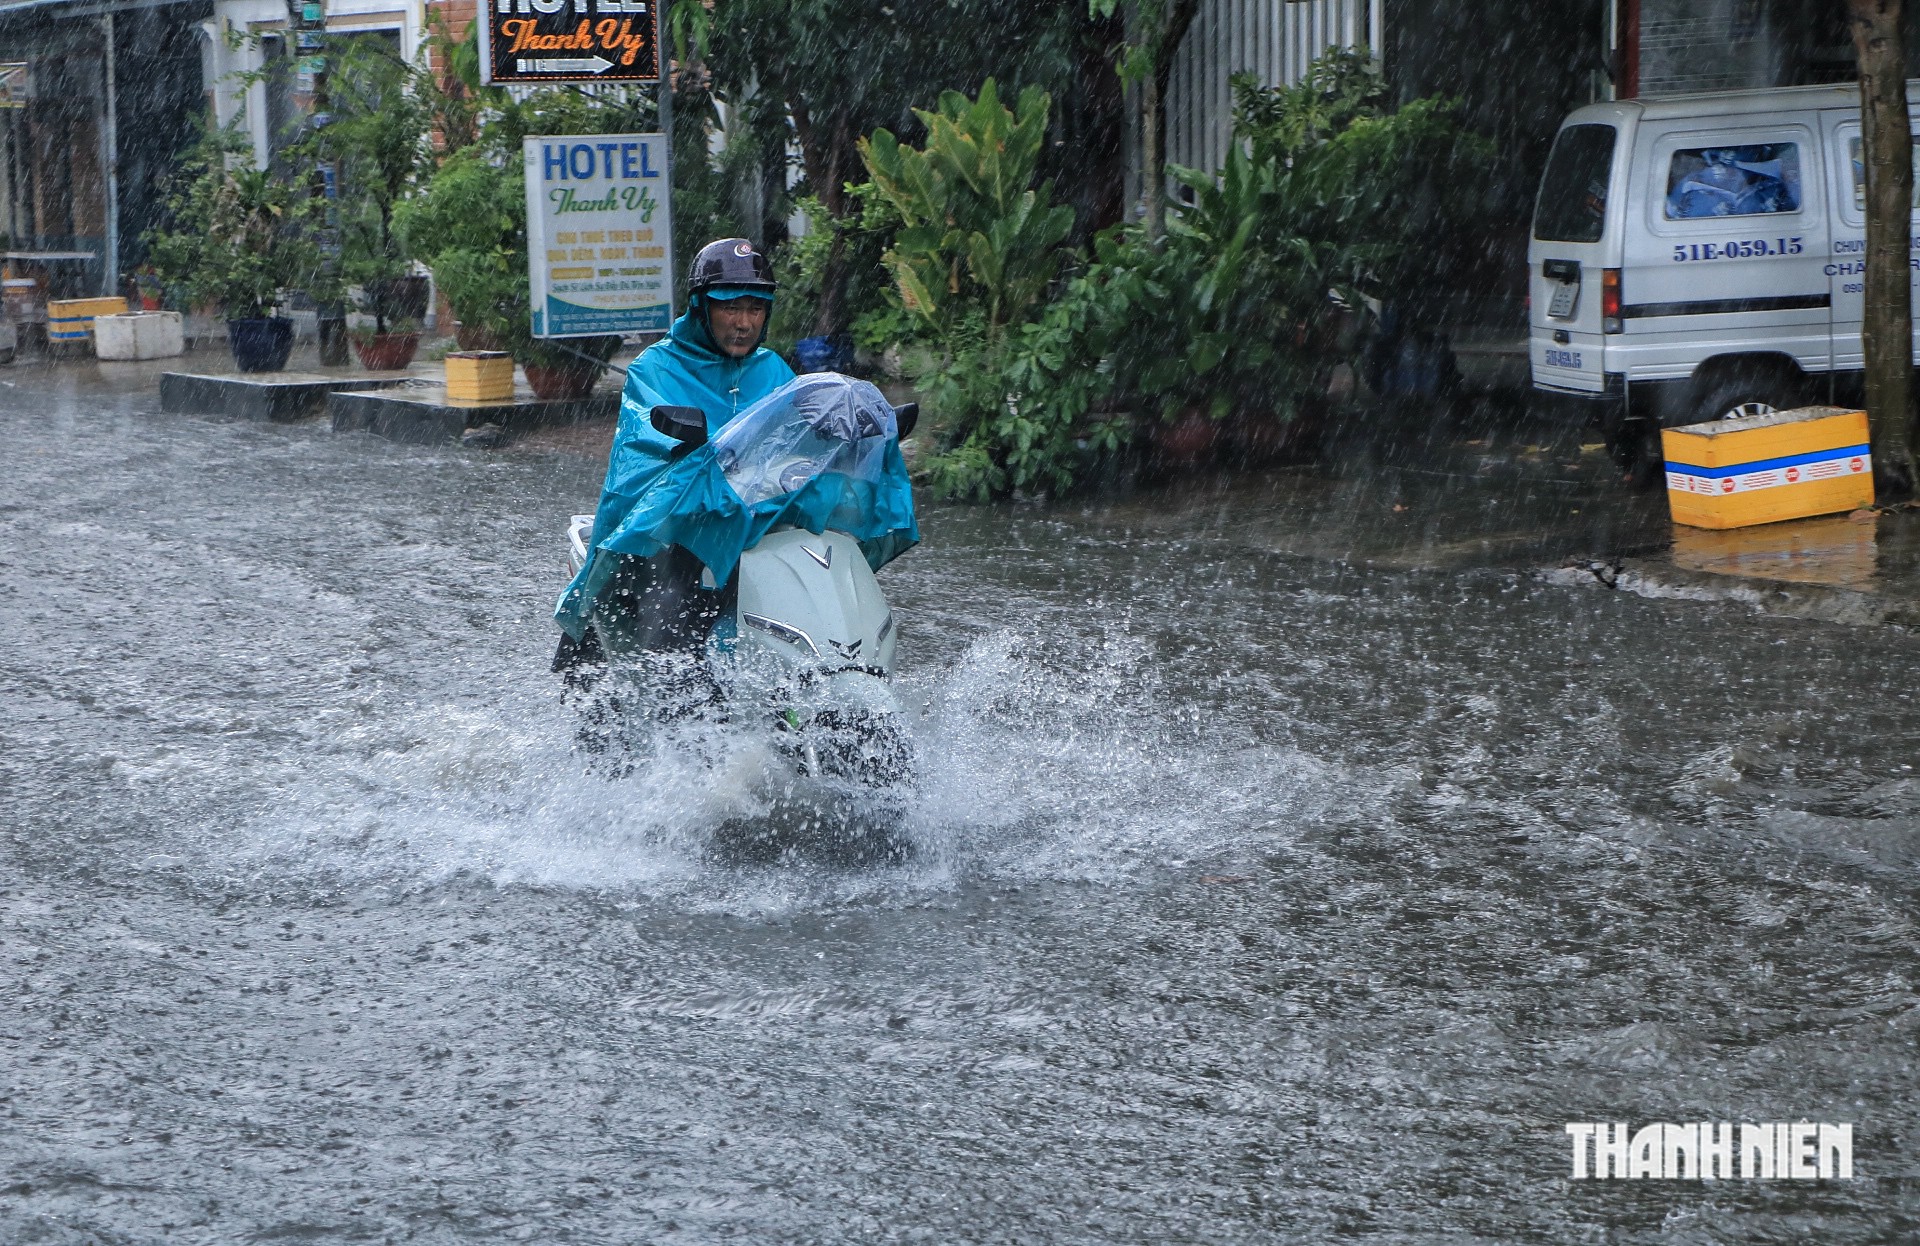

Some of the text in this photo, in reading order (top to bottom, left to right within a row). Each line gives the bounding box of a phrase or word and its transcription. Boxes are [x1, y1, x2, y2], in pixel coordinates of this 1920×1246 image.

[501, 18, 645, 66] Thanh Vy
[544, 143, 659, 180] HOTEL
[549, 186, 658, 223] Thanh Vy
[1673, 237, 1803, 262] 51E-059.15
